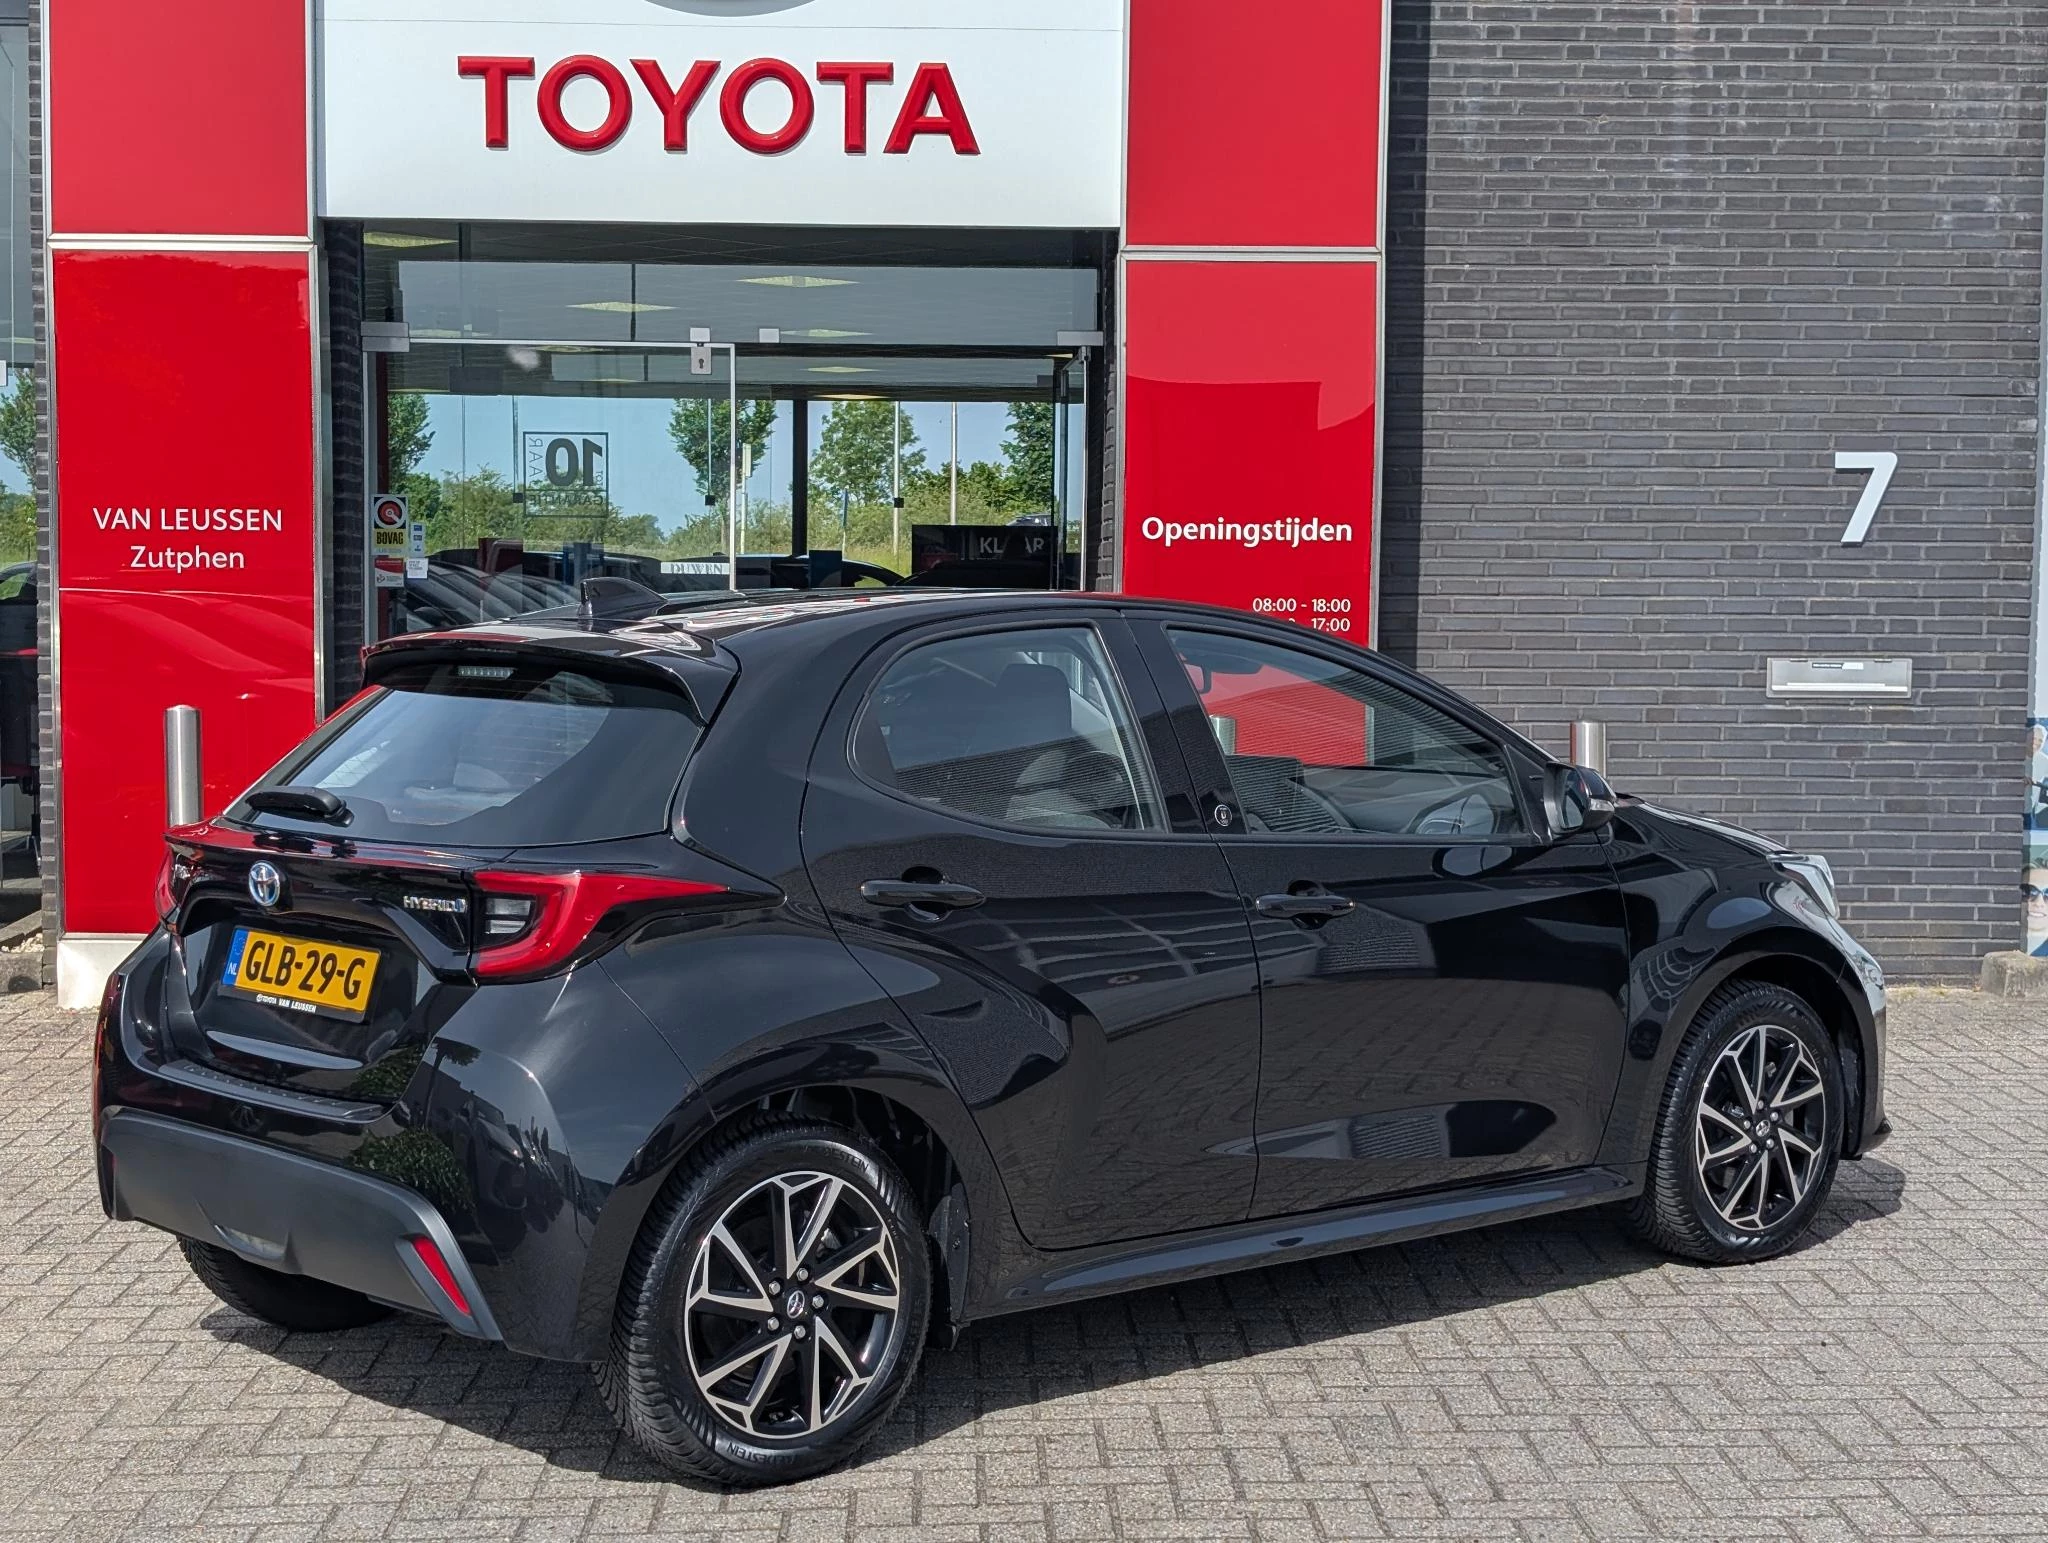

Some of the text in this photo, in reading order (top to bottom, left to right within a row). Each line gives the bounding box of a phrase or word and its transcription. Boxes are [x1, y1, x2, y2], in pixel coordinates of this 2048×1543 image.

[458, 55, 979, 155] TOYOTA
[1834, 451, 1898, 544] 7
[93, 507, 282, 531] VAN LEUSSEN
[376, 531, 404, 545] BOVAG
[1141, 516, 1354, 549] Openingstijden
[130, 545, 245, 574] Zutphen
[1252, 597, 1297, 613] 08:00
[1311, 598, 1351, 613] 18:00
[1311, 617, 1351, 632] 17:00
[403, 895, 457, 912] HYBRID
[227, 962, 238, 976] NL
[245, 939, 366, 1001] GLB-29-G
[278, 998, 290, 1008] VAN
[291, 1001, 317, 1014] LEUSSEN
